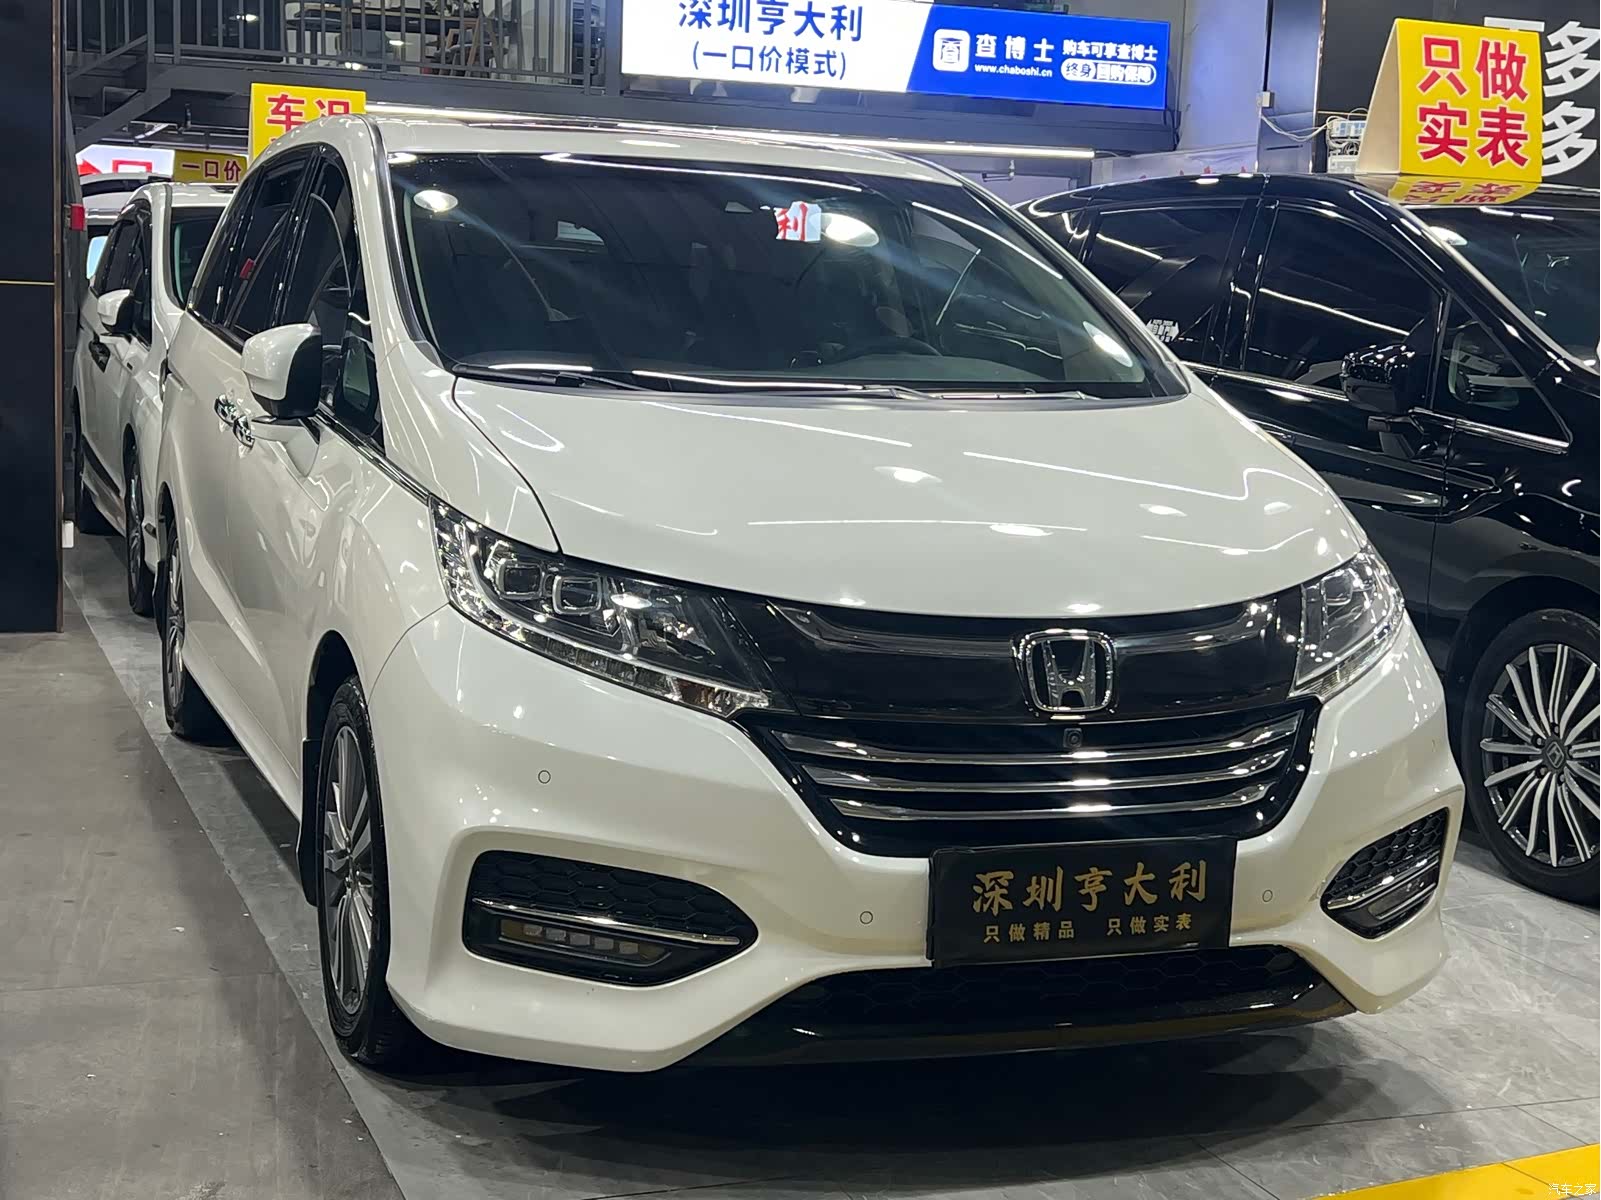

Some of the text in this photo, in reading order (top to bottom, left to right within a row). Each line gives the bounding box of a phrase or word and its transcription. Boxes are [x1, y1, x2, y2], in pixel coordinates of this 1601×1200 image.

[679, 0, 863, 42] 深圳亨大利
[975, 34, 1055, 63] 查博士
[975, 63, 1053, 78] www.chaboshi.cn
[1418, 35, 1529, 101] 只做
[1418, 102, 1530, 168] 实表
[182, 160, 243, 181] 一口价
[971, 860, 1207, 917] 深圳亨大利
[983, 912, 1193, 944] 只做精品 只做实表
